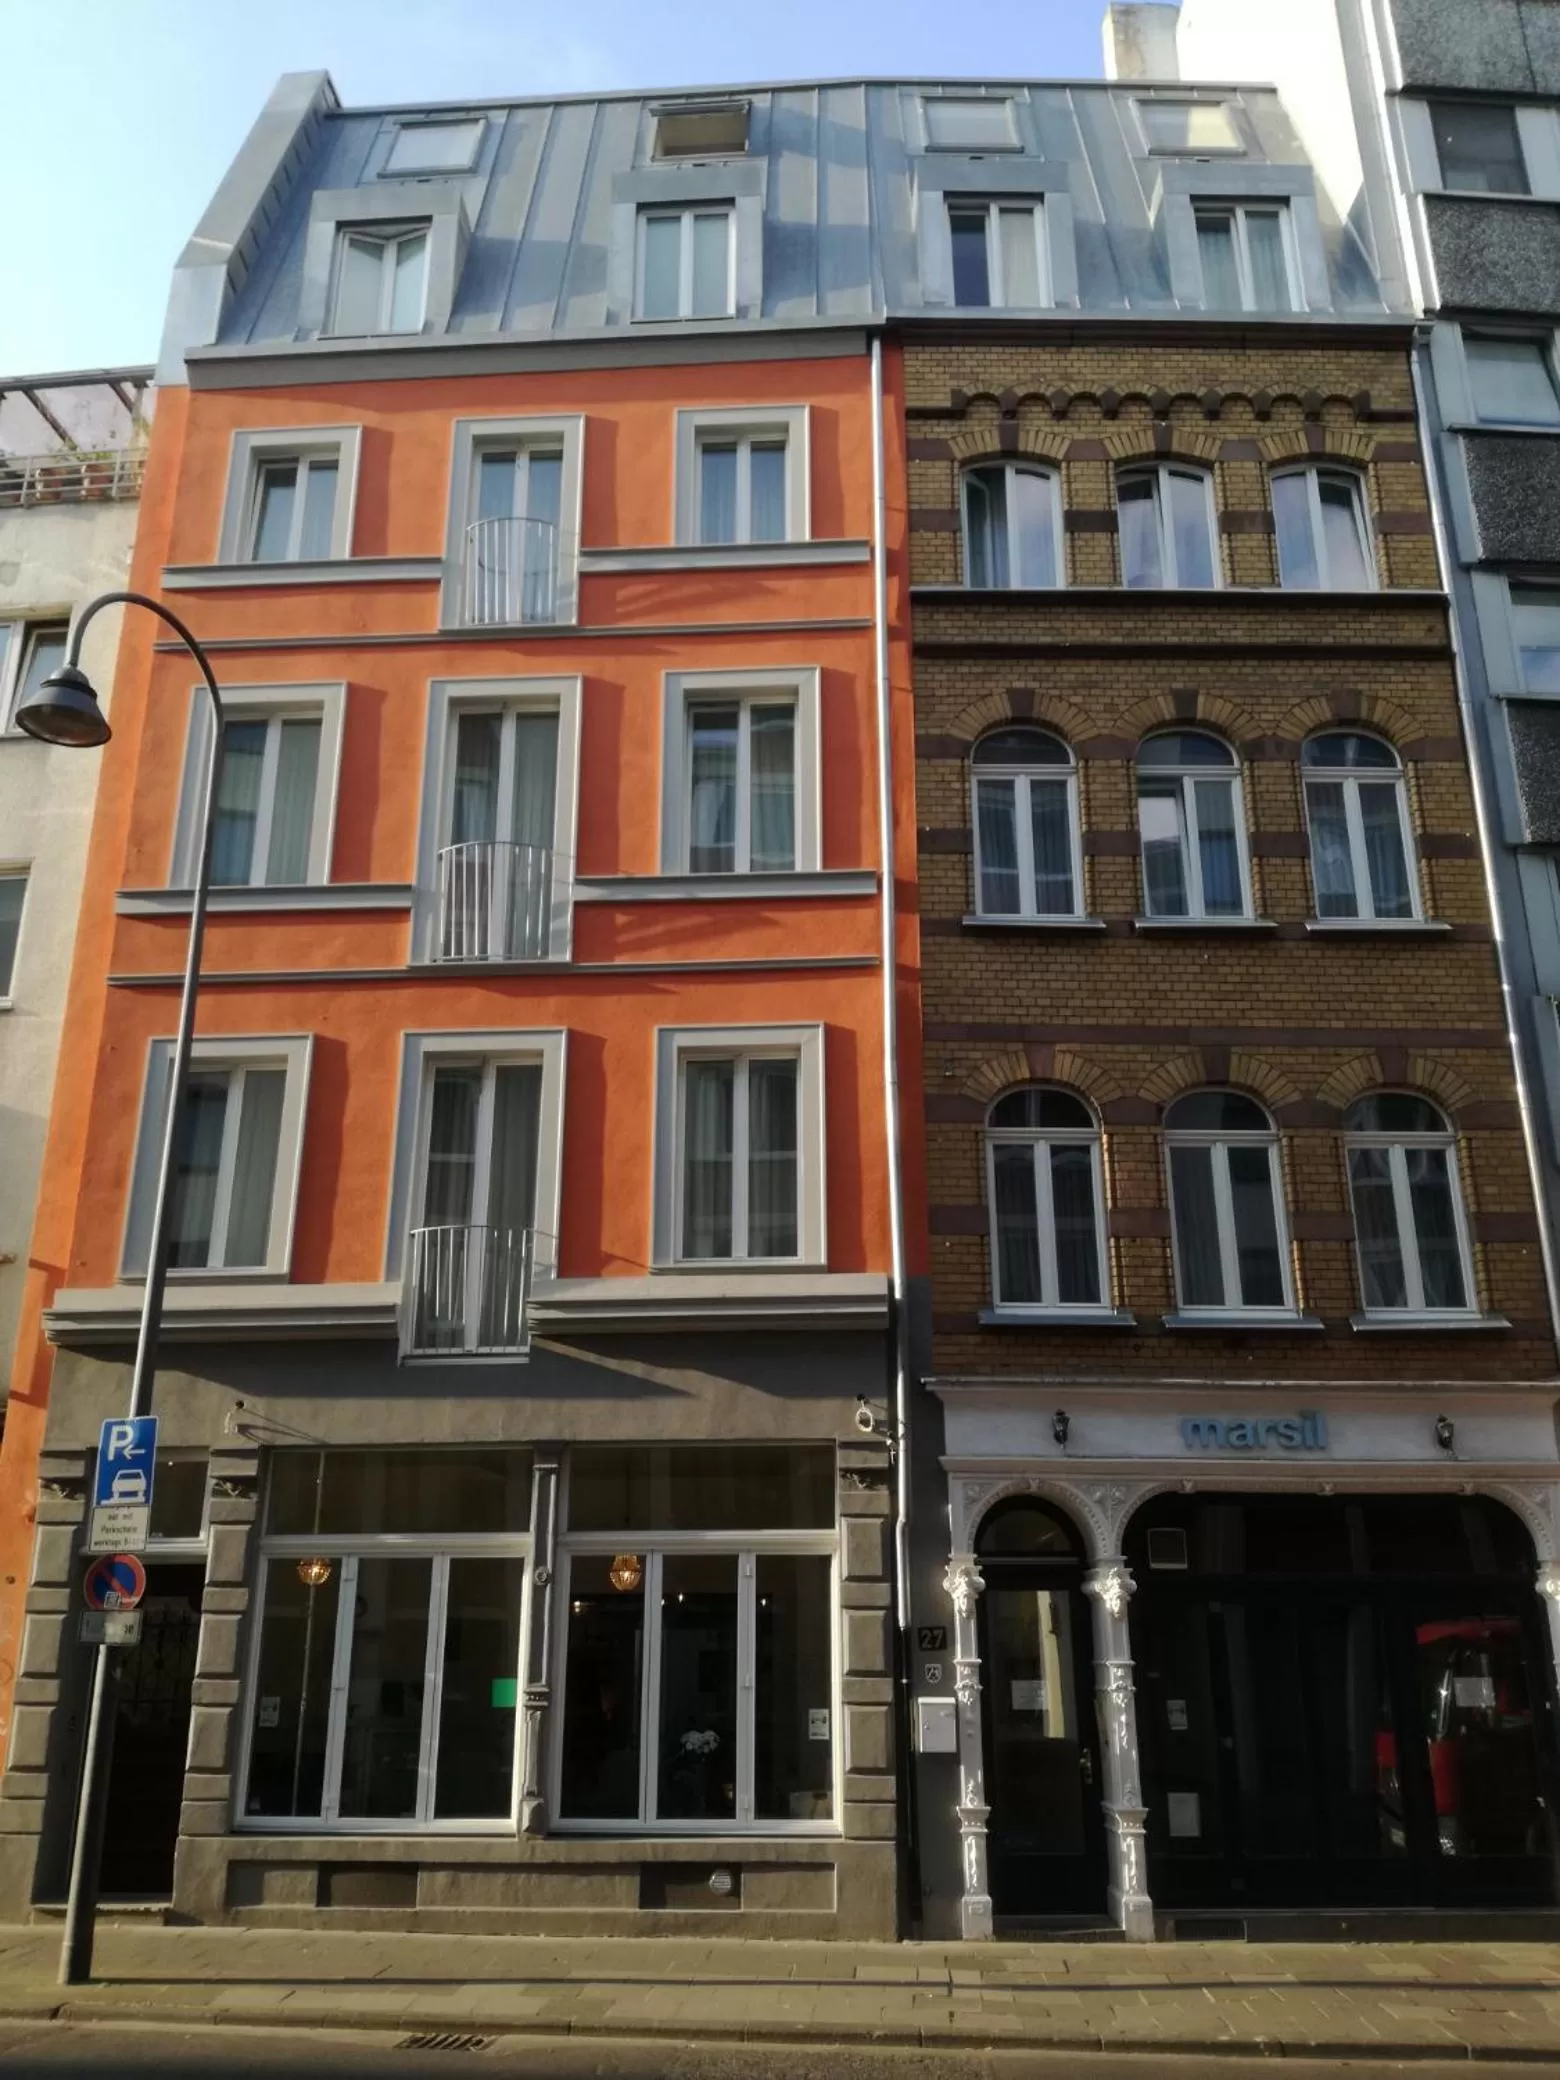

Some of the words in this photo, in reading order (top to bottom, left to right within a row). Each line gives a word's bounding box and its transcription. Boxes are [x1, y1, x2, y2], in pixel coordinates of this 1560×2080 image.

[107, 1424, 134, 1461] P
[1179, 1411, 1328, 1449] marsil
[921, 1628, 944, 1649] 27
